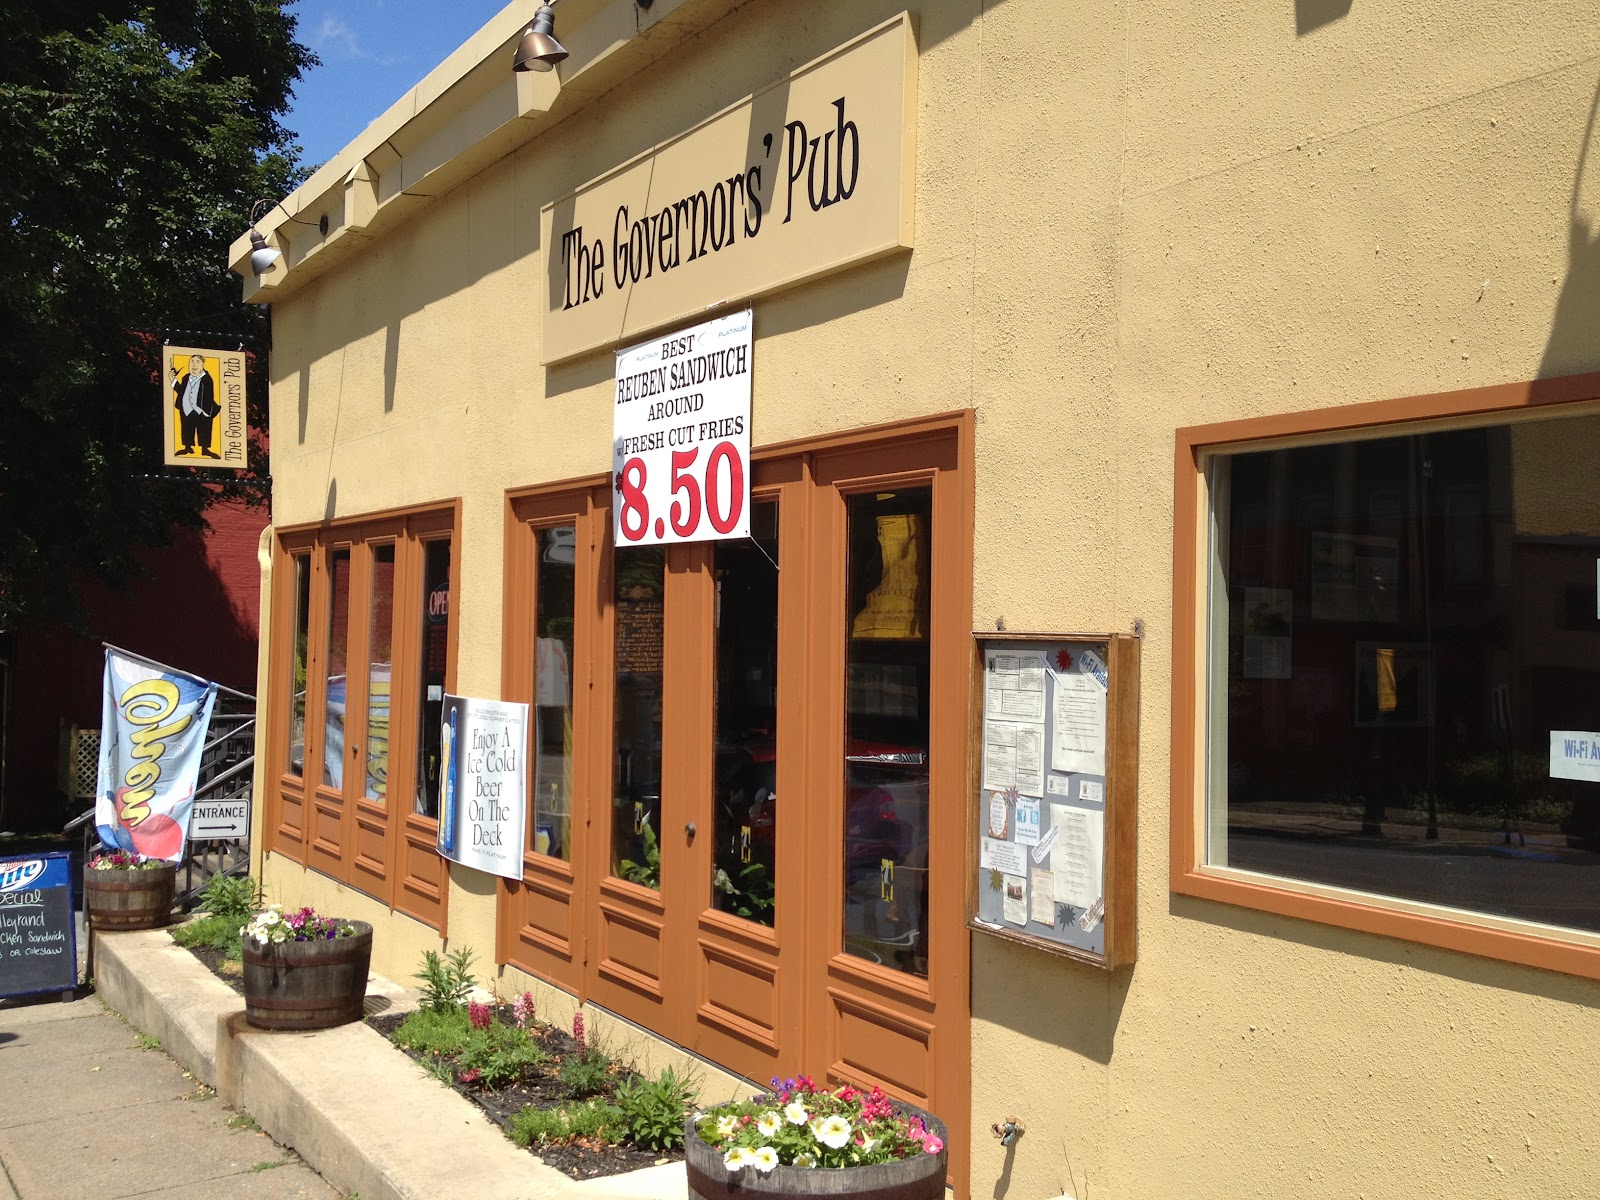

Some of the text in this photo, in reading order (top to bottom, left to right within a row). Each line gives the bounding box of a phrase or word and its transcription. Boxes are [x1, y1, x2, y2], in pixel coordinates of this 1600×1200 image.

[562, 96, 859, 311] The Governors' Pub
[718, 325, 747, 337] PLATINUM
[636, 351, 659, 362] PLATINUM
[661, 334, 695, 361] BEST
[223, 357, 241, 378] Pub
[617, 344, 748, 405] REUBEN SANDWICH
[647, 393, 704, 422] AROUND
[668, 424, 695, 447] CUT
[699, 415, 744, 441] FRIES
[224, 441, 242, 461] The
[430, 590, 449, 615] OPE
[472, 725, 510, 756] Enjoy A
[467, 749, 515, 773] Ice Cold
[476, 775, 502, 797] Beer
[192, 807, 245, 819] ENTRANCE
[468, 798, 510, 821] On The
[473, 822, 502, 846] Deck
[28, 930, 66, 943] Sandwich
